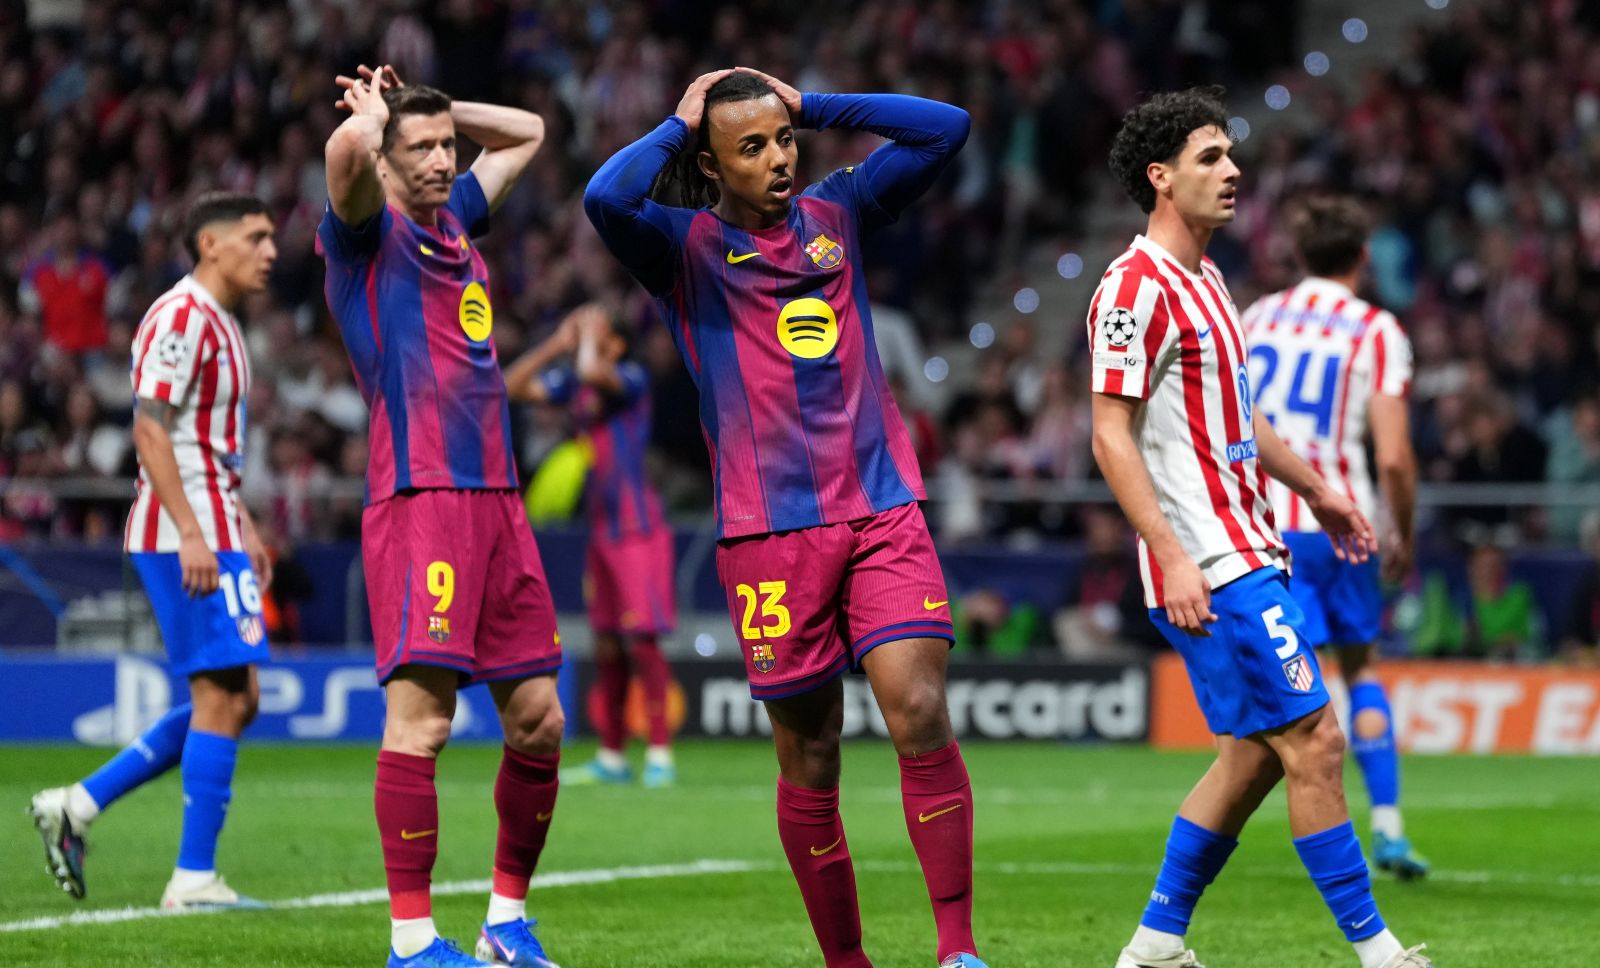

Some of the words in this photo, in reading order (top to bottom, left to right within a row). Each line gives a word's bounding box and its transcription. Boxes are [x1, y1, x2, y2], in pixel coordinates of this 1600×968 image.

[1250, 344, 1341, 438] 24
[219, 568, 262, 618] 16
[426, 560, 455, 613] 9
[735, 580, 792, 640] 23
[1261, 604, 1299, 660] 5
[702, 667, 1146, 738] mstrcard
